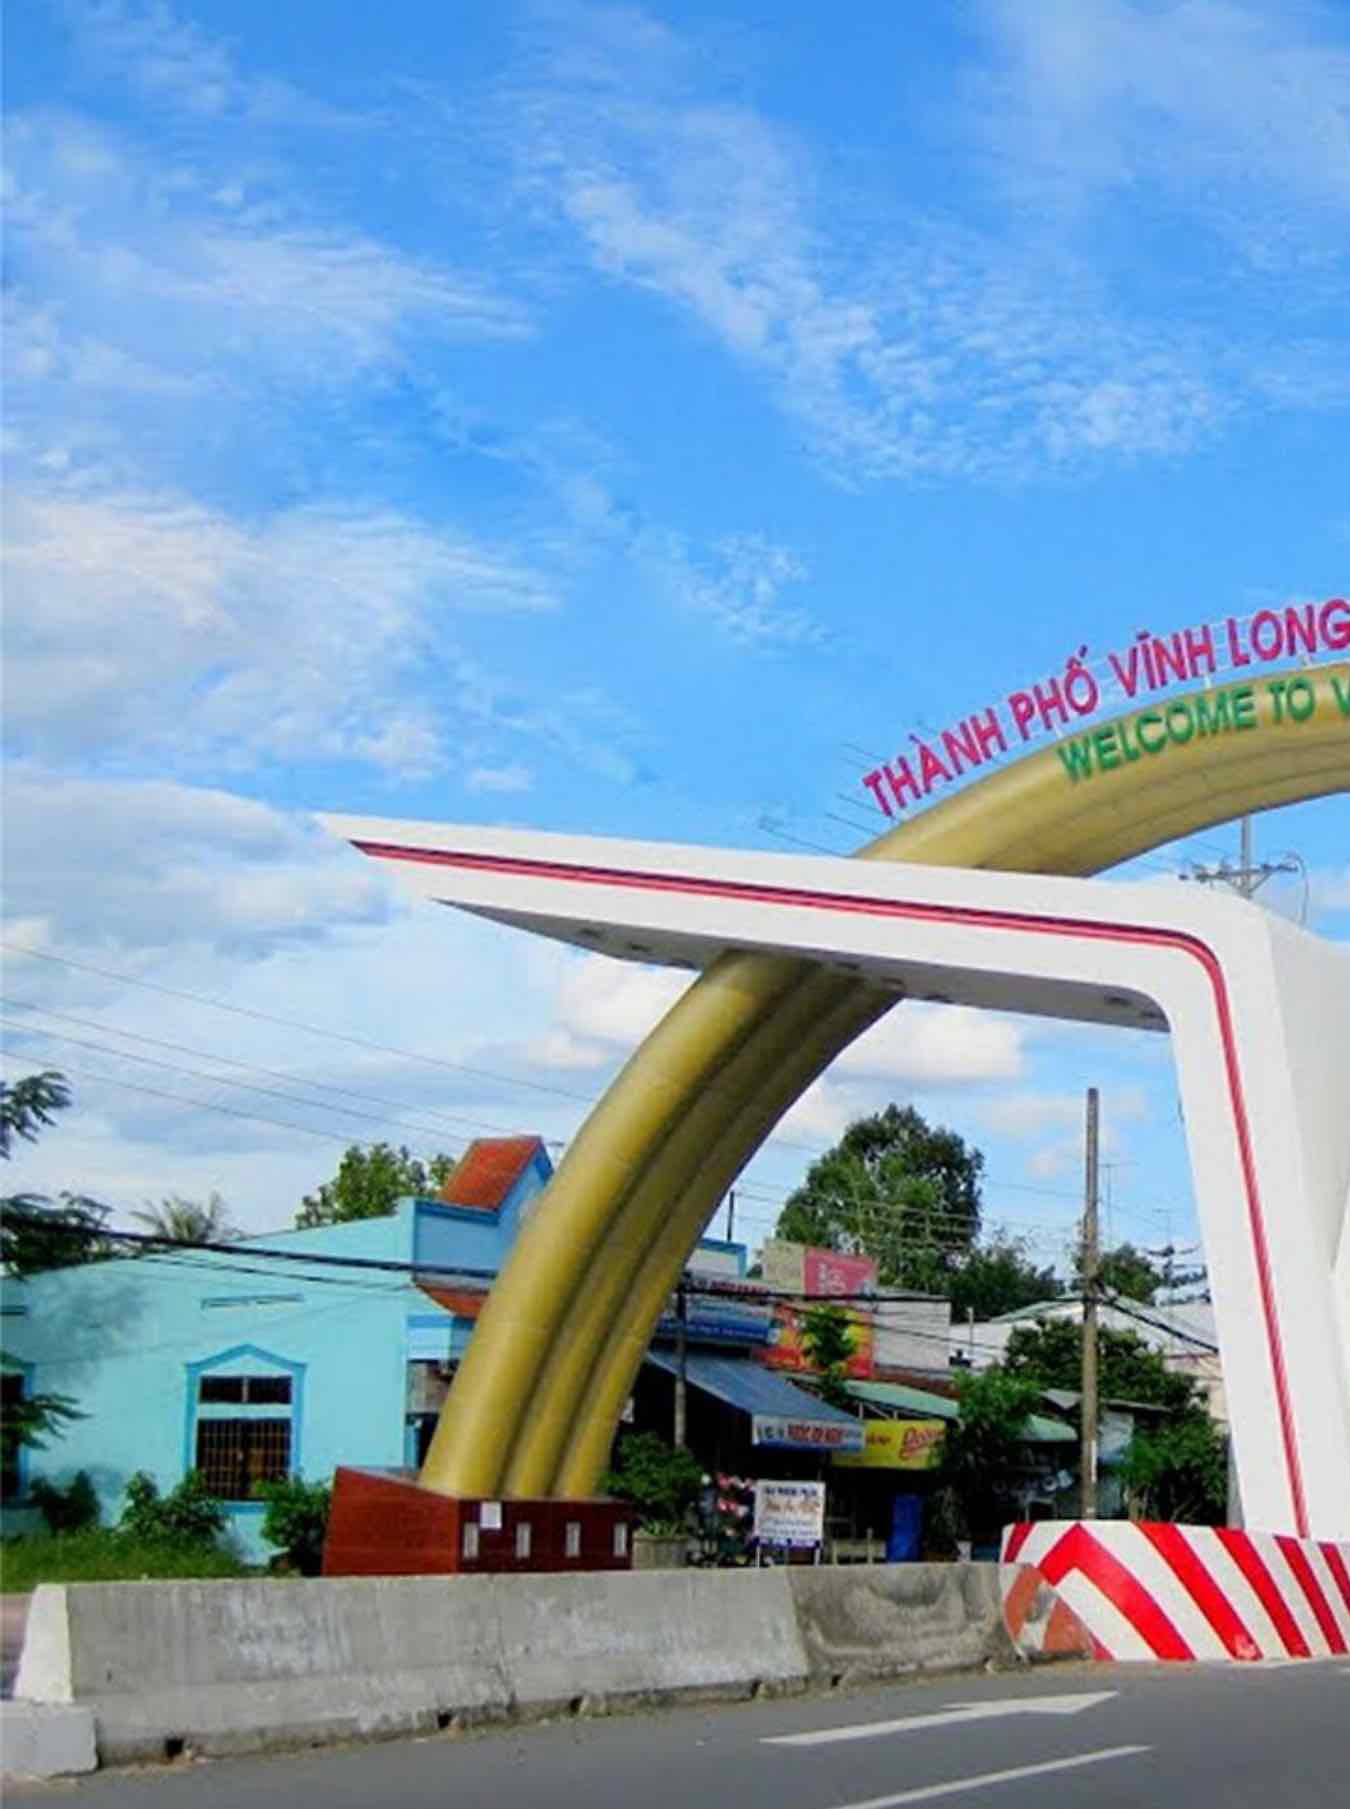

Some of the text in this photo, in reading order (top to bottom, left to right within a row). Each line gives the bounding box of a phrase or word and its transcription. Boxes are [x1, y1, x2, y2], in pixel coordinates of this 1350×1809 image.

[862, 709, 1006, 817] THÀNH
[1007, 645, 1099, 741] PHỐ
[1109, 624, 1217, 698] VĨNH
[1056, 687, 1257, 784] WELCOME
[1267, 677, 1316, 722] TO
